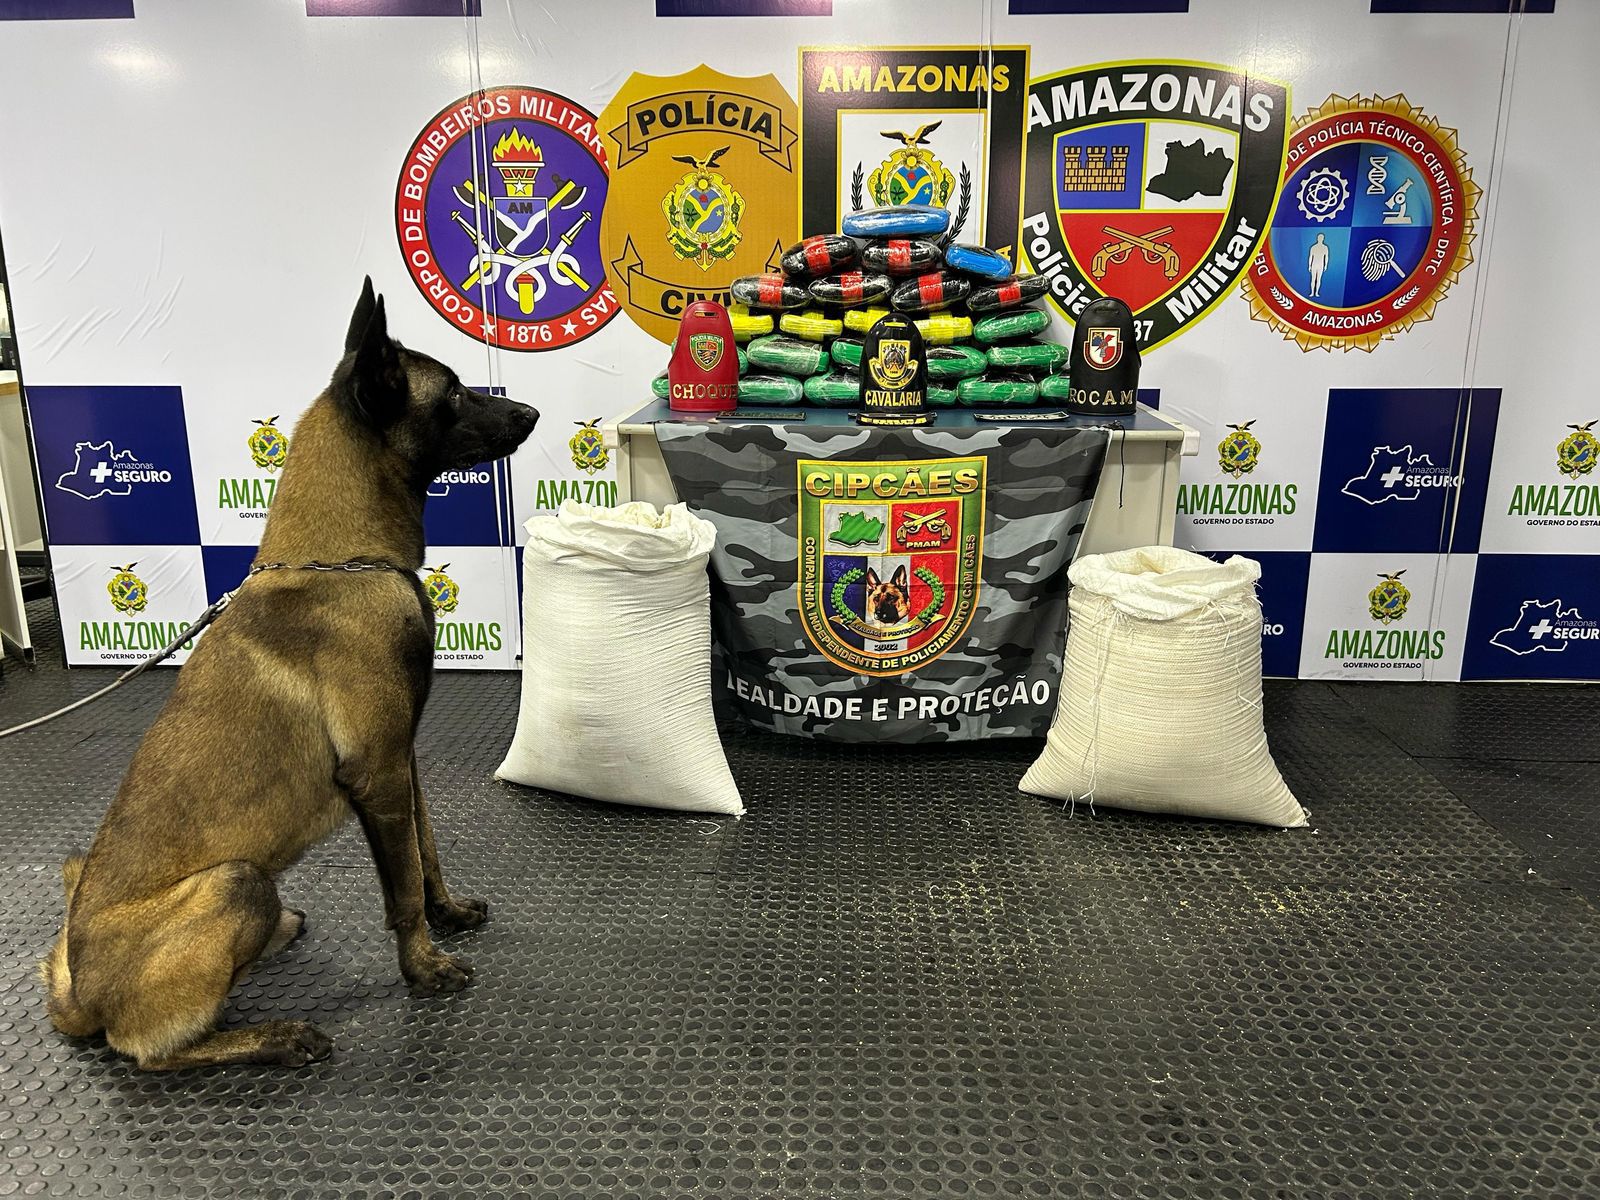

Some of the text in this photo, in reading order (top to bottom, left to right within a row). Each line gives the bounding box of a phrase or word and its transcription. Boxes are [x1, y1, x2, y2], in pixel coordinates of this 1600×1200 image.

[817, 65, 1010, 93] AMAZONAS
[635, 95, 773, 138] POLÍCIA
[1027, 73, 1274, 133] AMAZONAS
[404, 95, 511, 200] BOMBEIROS
[508, 202, 533, 213] AM
[1288, 120, 1454, 276] DE POLÍCIA TÉCNICO-CIENTÍFICA DPTC
[403, 208, 423, 242] DE
[1023, 212, 1258, 323] Polícia Militar
[412, 249, 474, 324] CORPO
[506, 323, 552, 343] 1876
[1134, 320, 1154, 341] 37
[1302, 309, 1383, 329] AMAZONAS
[672, 384, 737, 400] CHOQUE
[865, 390, 922, 407] CAVALARIA
[1069, 388, 1134, 406] ROCAM
[113, 462, 154, 470] Amazonas
[114, 470, 172, 483] SEGURO
[1406, 466, 1449, 474] Amazonas
[219, 479, 276, 509] AMAZ
[536, 480, 618, 509] AMAZON
[805, 467, 979, 497] CIPCÃES
[1405, 475, 1465, 487] SEGURO
[1176, 484, 1298, 515] AMAZONAS
[1507, 485, 1600, 516] AMAZON
[906, 541, 941, 549] PMAM
[805, 534, 976, 669] COMPANHIA INDEPENDENTE DE POLICIAMENTO COM CÃES
[435, 622, 502, 651] ZONAS
[1553, 627, 1600, 640] SEGUR
[1554, 619, 1597, 627] Amazonas
[874, 643, 899, 652] 2002
[1324, 630, 1446, 660] AMAZONAS
[872, 698, 889, 721] E
[897, 675, 1050, 720] PROTEÇÃO
